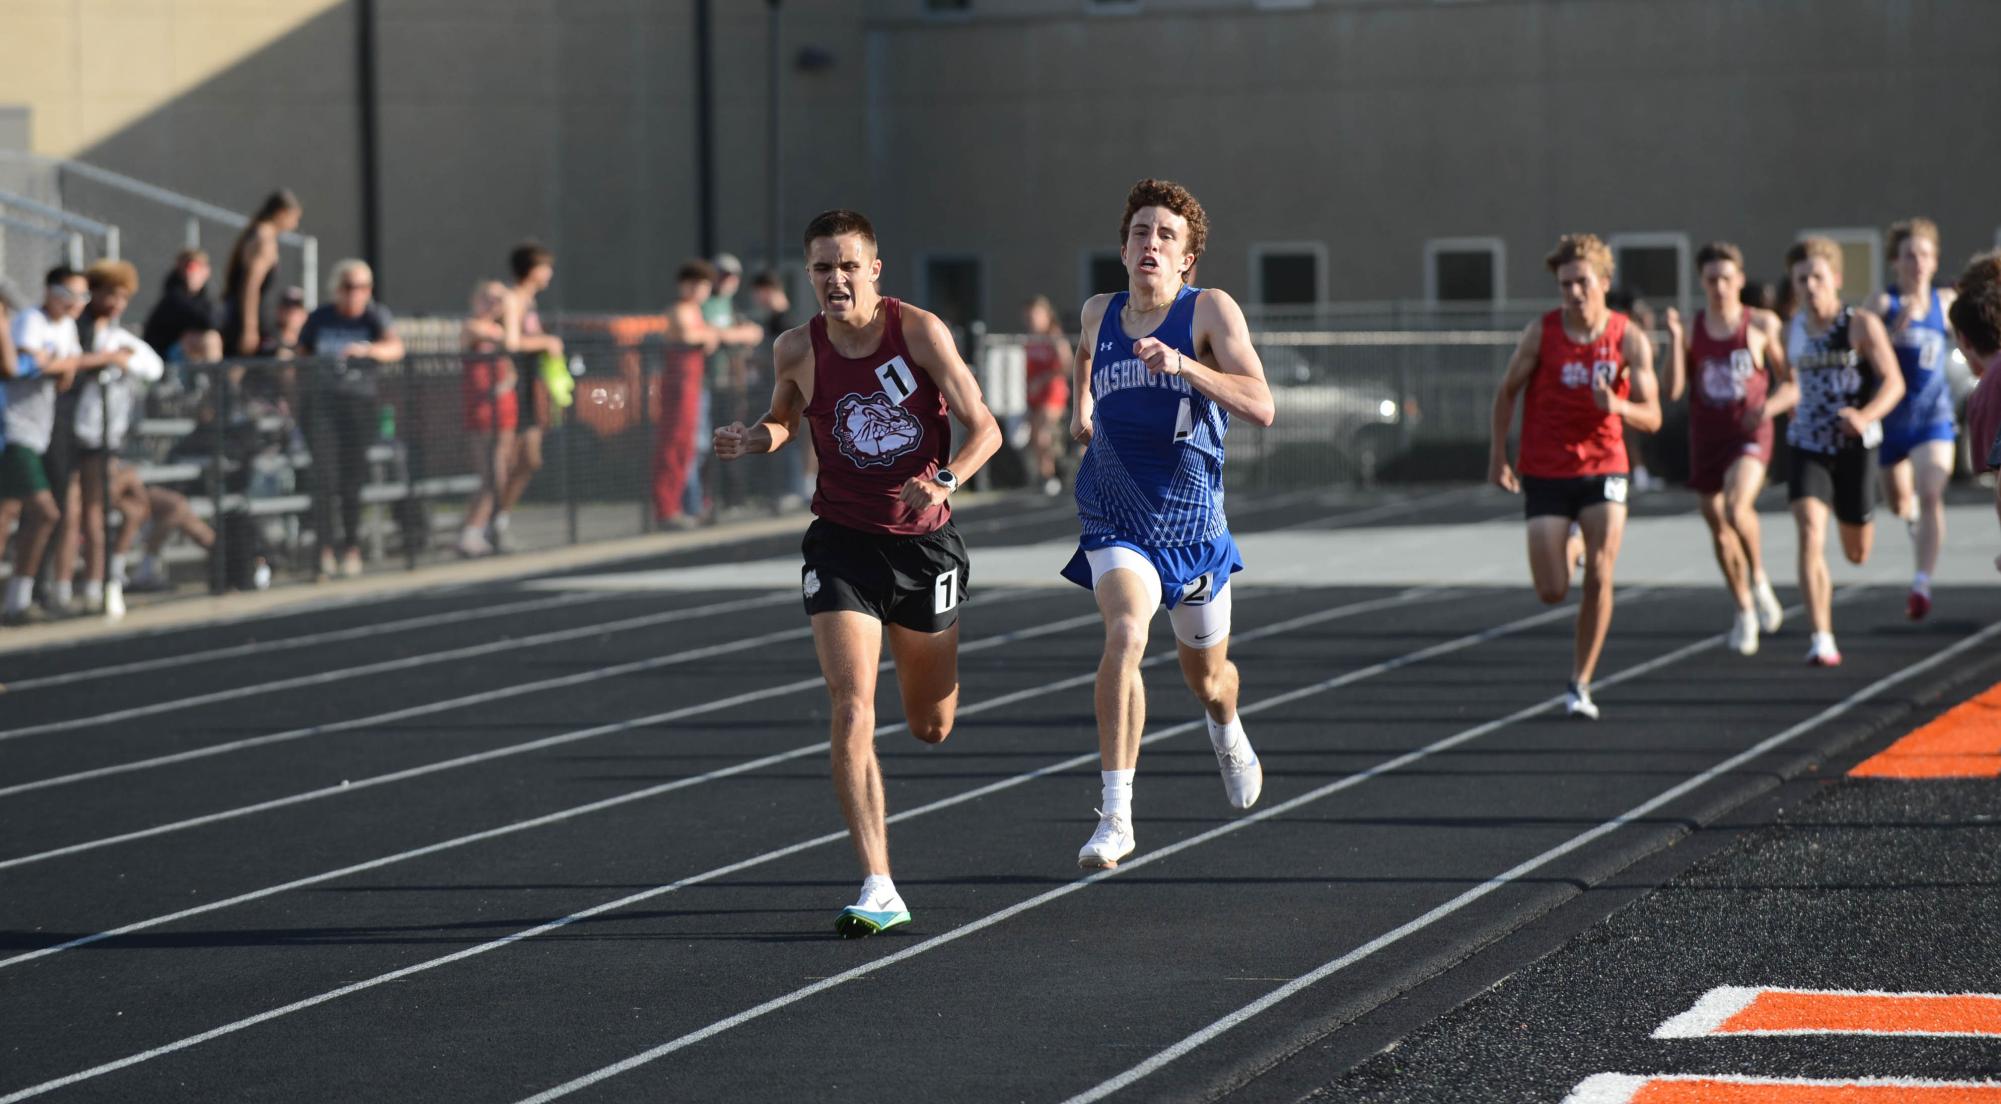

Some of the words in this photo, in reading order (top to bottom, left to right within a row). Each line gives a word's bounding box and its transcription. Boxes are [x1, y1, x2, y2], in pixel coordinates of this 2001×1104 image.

[883, 363, 910, 397] 1
[939, 574, 954, 608] 1
[1183, 574, 1209, 602] 2
